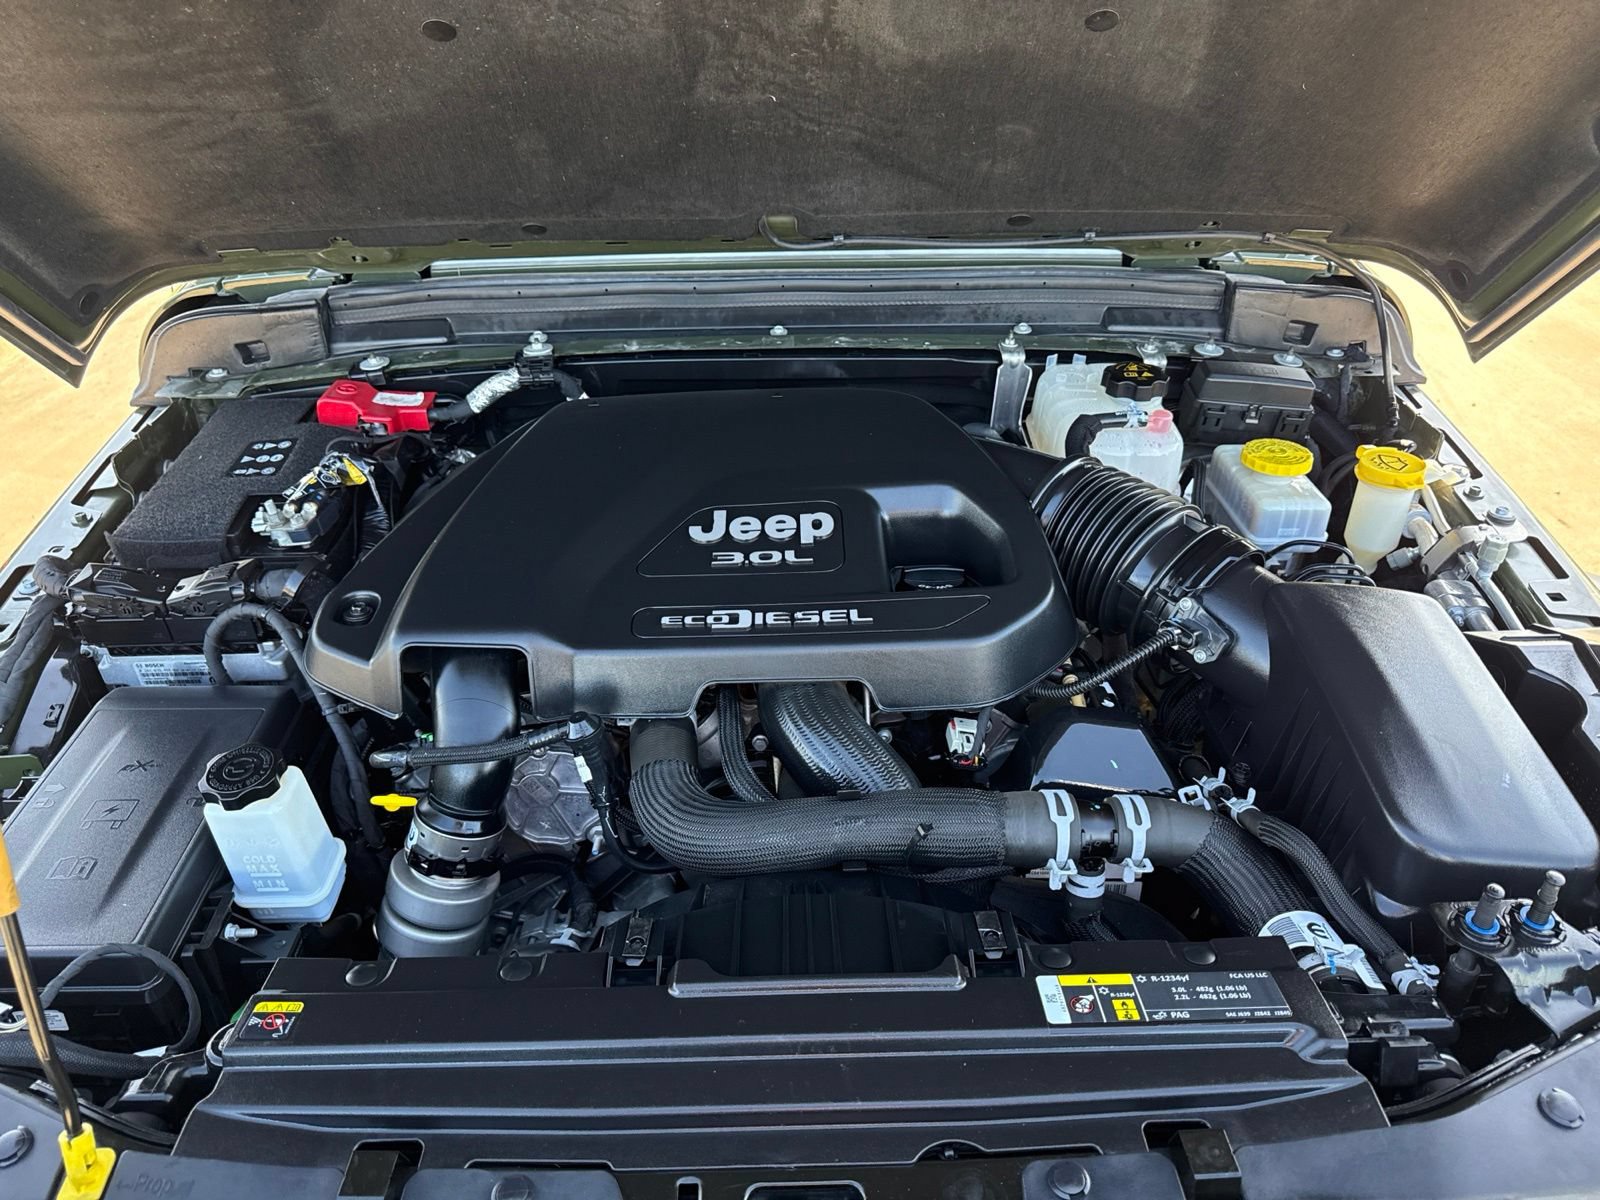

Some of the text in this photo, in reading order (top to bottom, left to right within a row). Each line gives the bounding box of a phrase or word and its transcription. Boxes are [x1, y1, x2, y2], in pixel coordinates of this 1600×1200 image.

[688, 509, 835, 546] Jeep
[710, 550, 814, 567] 3.0L
[242, 855, 276, 864] COLD
[245, 864, 280, 873] MAX
[252, 879, 287, 889] MIN
[1150, 974, 1190, 982] R-1234yf
[1170, 1011, 1190, 1019] PAG
[133, 1173, 173, 1198] Prop
